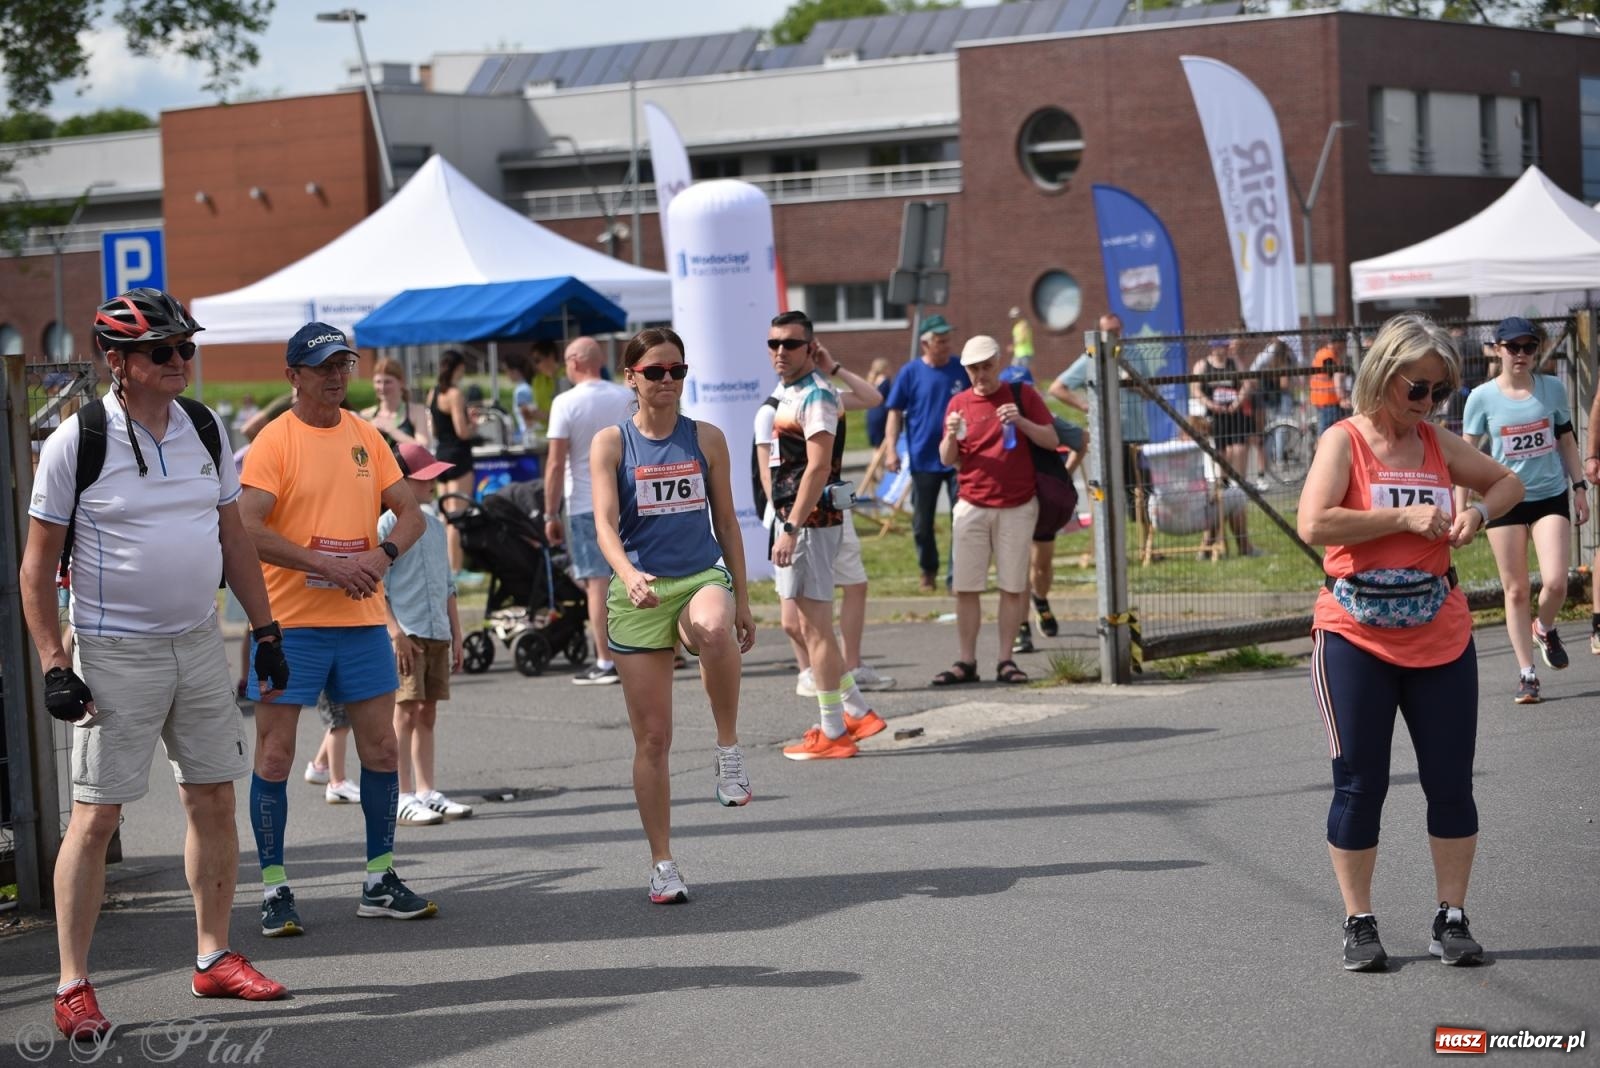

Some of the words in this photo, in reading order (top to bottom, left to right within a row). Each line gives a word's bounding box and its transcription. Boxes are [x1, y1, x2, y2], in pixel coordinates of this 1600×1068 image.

[114, 236, 152, 296] P
[1512, 432, 1544, 451] 228
[652, 478, 692, 502] 176
[1388, 487, 1435, 508] 175
